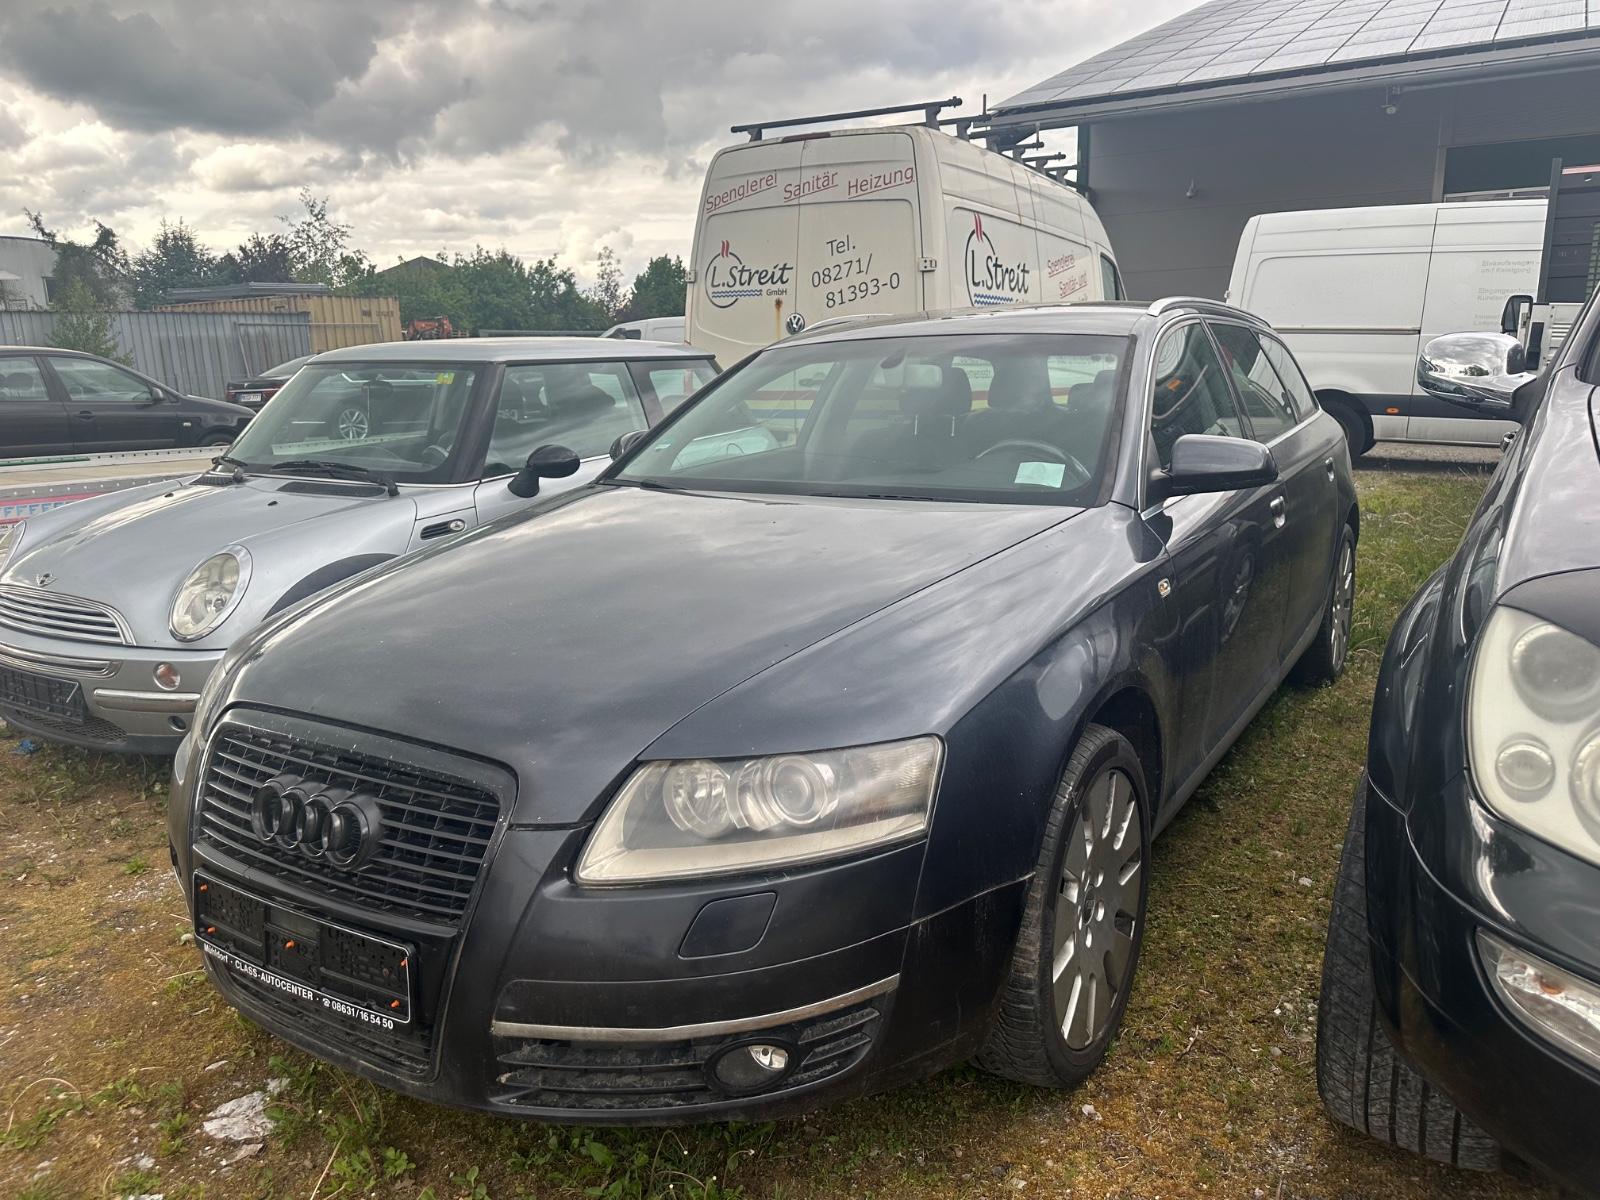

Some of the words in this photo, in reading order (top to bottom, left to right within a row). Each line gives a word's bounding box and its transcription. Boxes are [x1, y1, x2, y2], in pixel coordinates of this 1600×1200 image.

[706, 170, 778, 211] Spenglerei
[783, 171, 838, 200] Sanitär
[848, 167, 914, 196] Heizung
[826, 235, 856, 256] Tel.
[812, 253, 873, 288] 08271/
[766, 288, 788, 297] GmbH
[826, 272, 900, 309] 81393-0
[235, 960, 314, 1001] CLASS-AUTOCENTER
[370, 1013, 381, 1026] 54
[382, 1017, 394, 1030] 50
